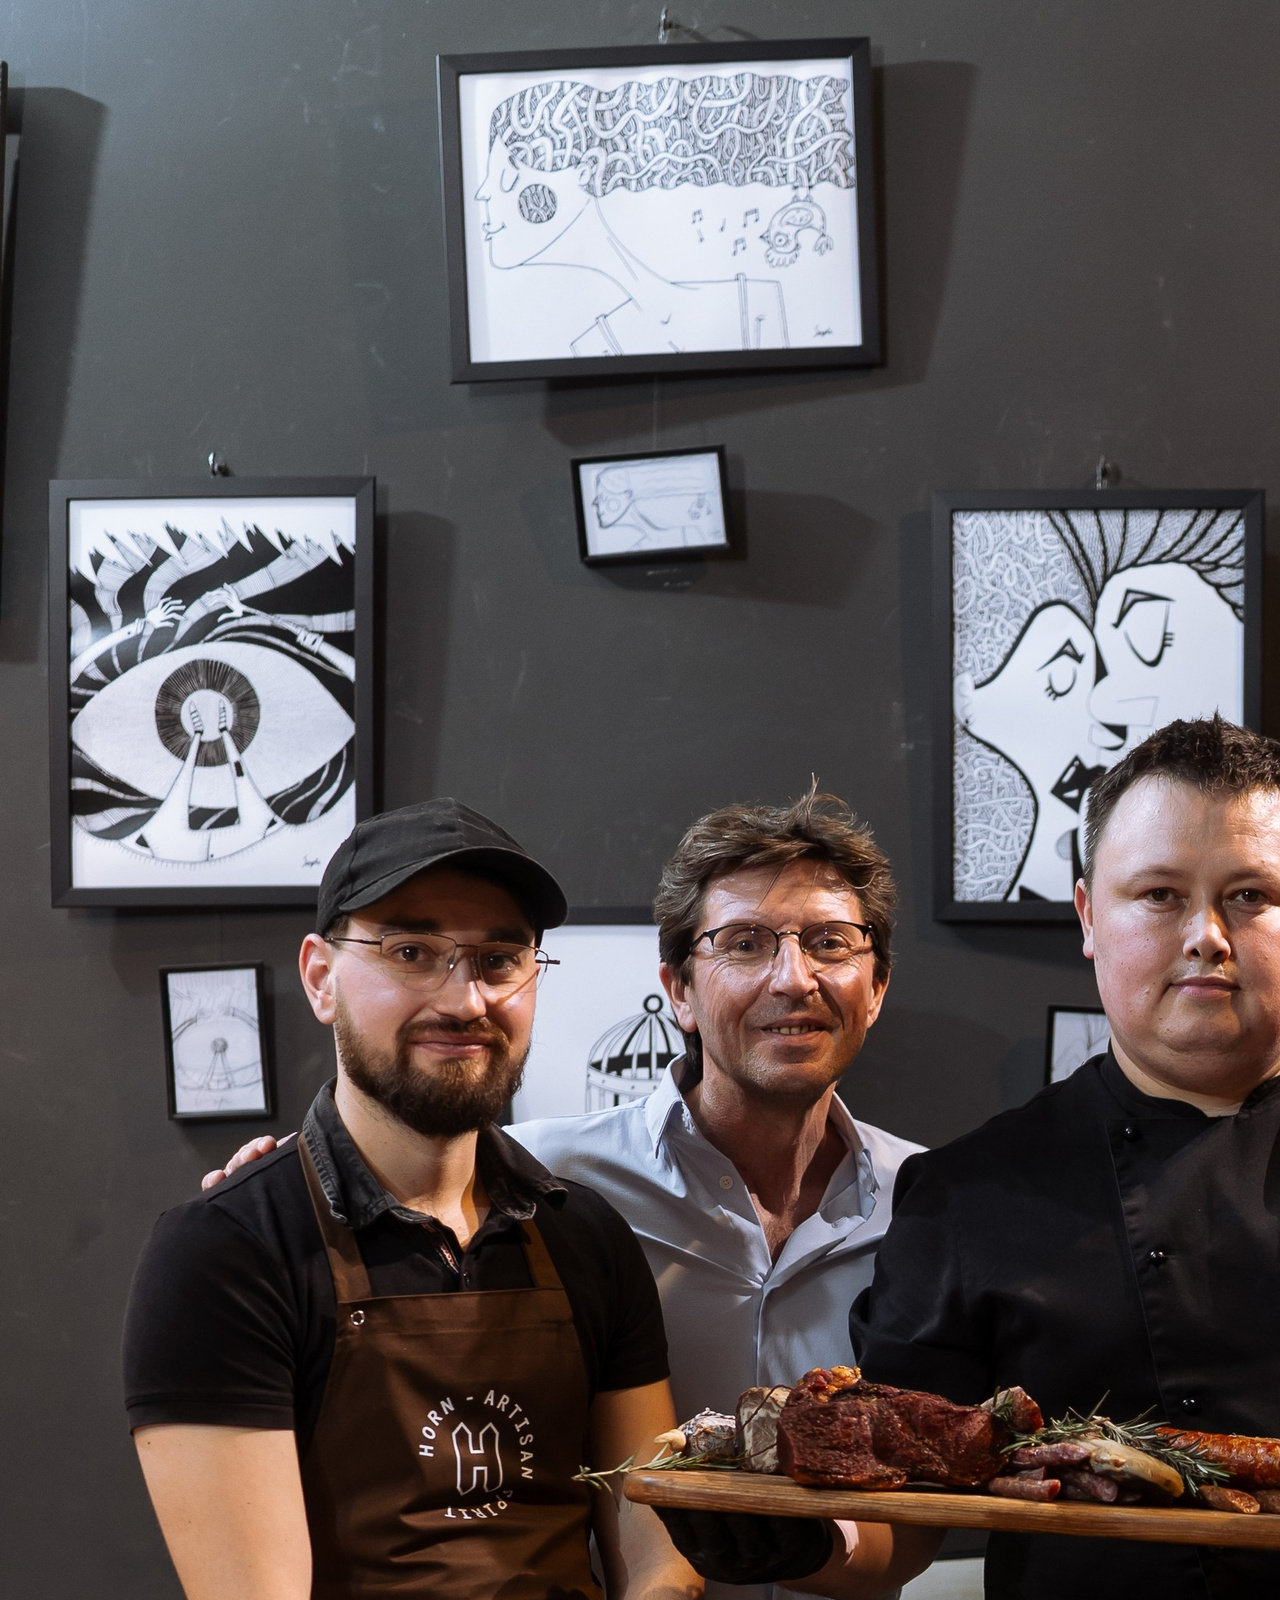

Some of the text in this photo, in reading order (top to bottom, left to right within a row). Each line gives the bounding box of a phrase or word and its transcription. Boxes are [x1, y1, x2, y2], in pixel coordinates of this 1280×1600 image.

[418, 1397, 455, 1458] HORN
[483, 1389, 534, 1480] ARTISAN
[444, 1489, 514, 1520] SPIRIT
